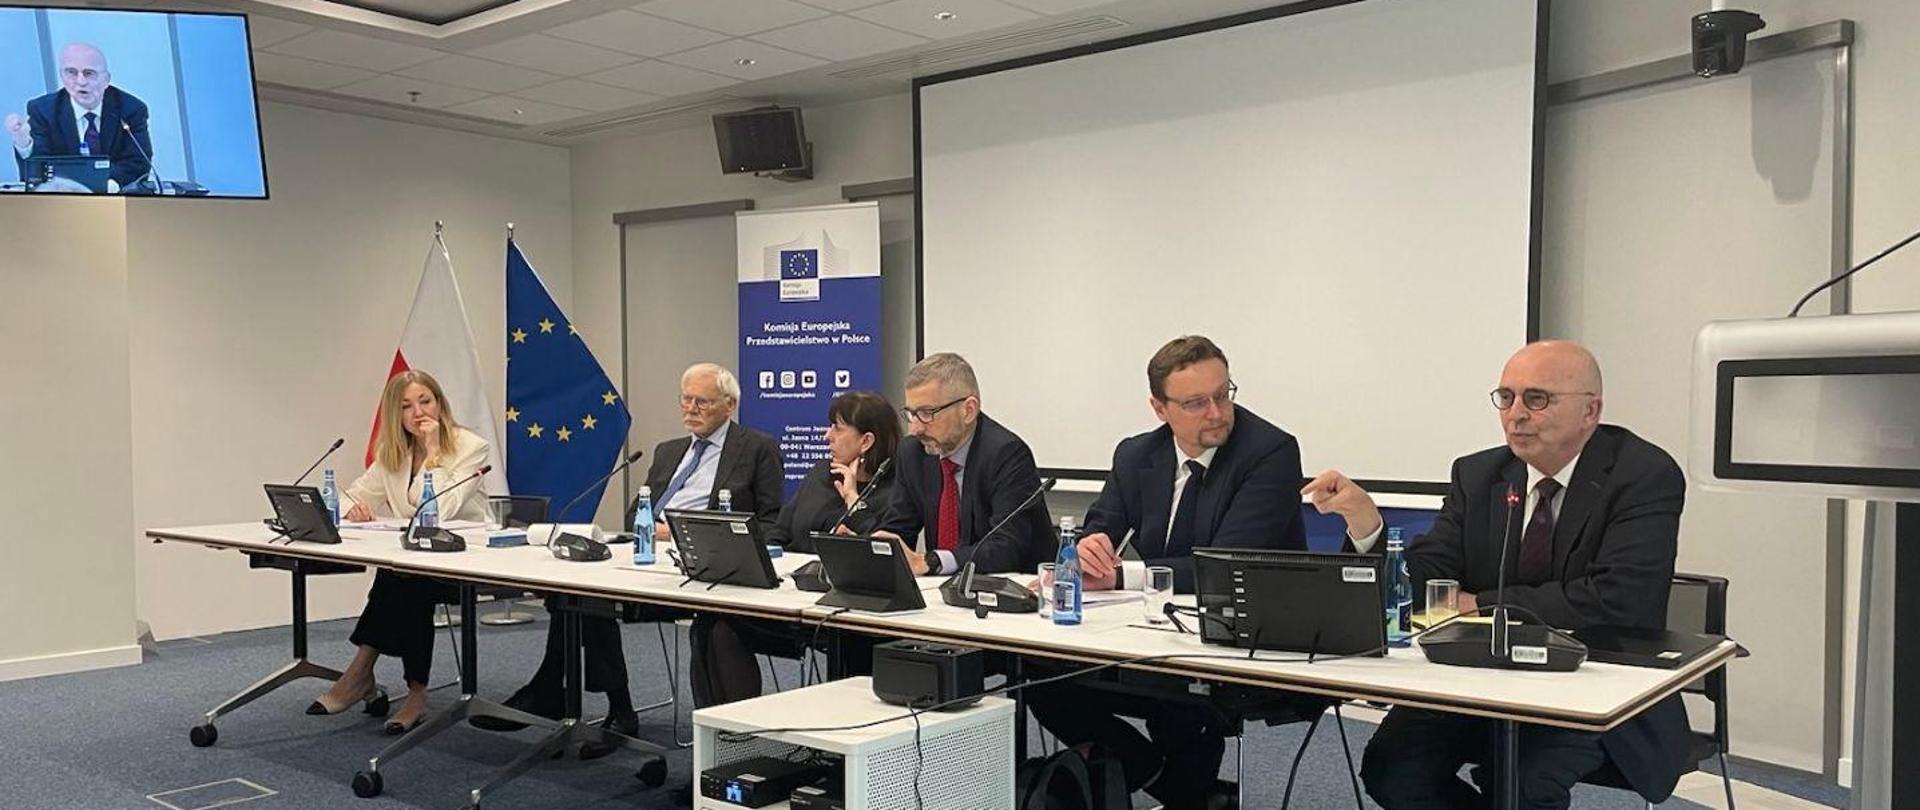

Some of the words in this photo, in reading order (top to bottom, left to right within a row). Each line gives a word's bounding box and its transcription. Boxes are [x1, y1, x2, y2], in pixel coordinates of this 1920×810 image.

[764, 322, 799, 333] Komisja
[802, 321, 851, 333] Europejska
[746, 335, 830, 346] Przedstawicielstwo
[832, 336, 840, 344] w
[842, 334, 871, 344] Polsce
